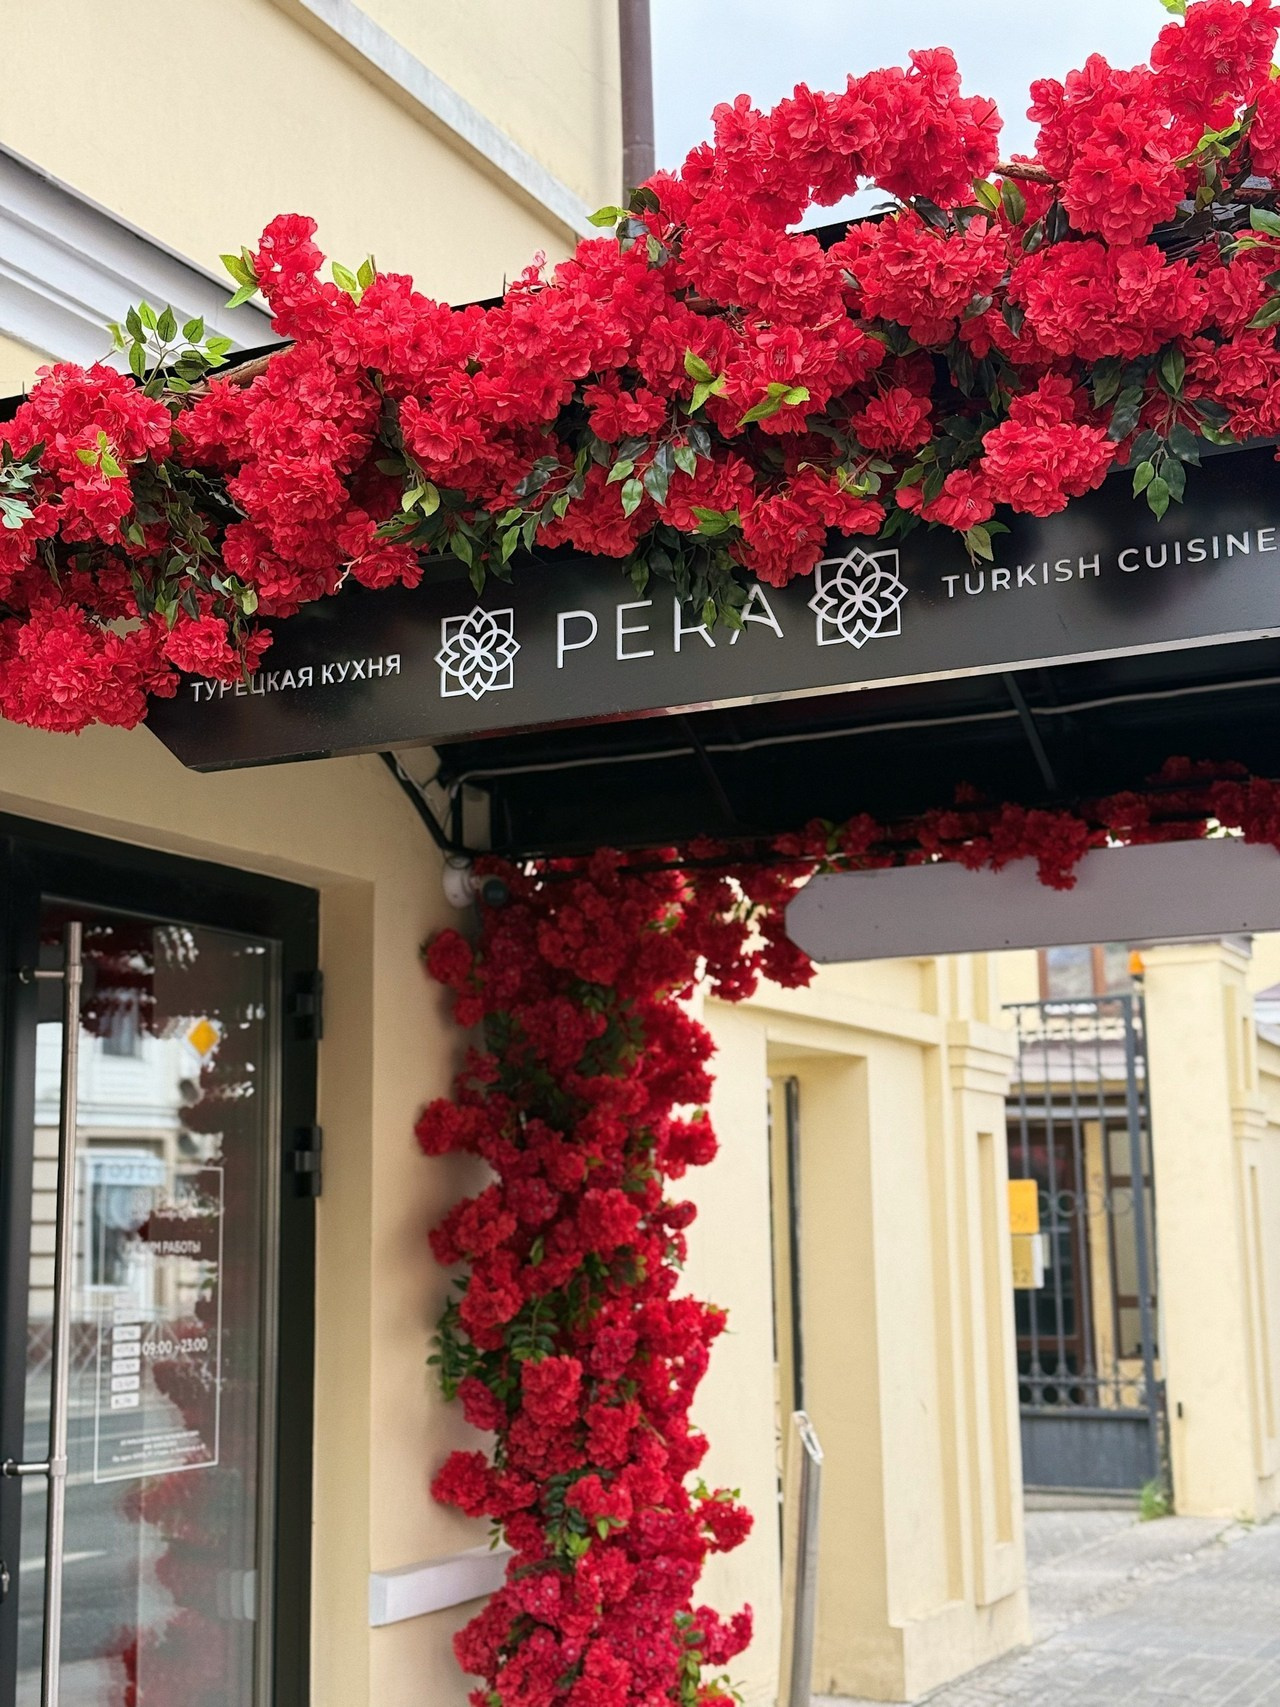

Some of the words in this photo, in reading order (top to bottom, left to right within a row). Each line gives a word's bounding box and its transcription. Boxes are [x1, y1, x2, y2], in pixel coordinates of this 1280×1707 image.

[941, 553, 1101, 598] TURKISH
[1117, 527, 1278, 573] CUISINE
[189, 666, 313, 702] ТУРЕЦКАЯ
[321, 654, 401, 685] КУХНЯ
[142, 1340, 172, 1356] 09:00
[181, 1337, 208, 1353] 23:00
